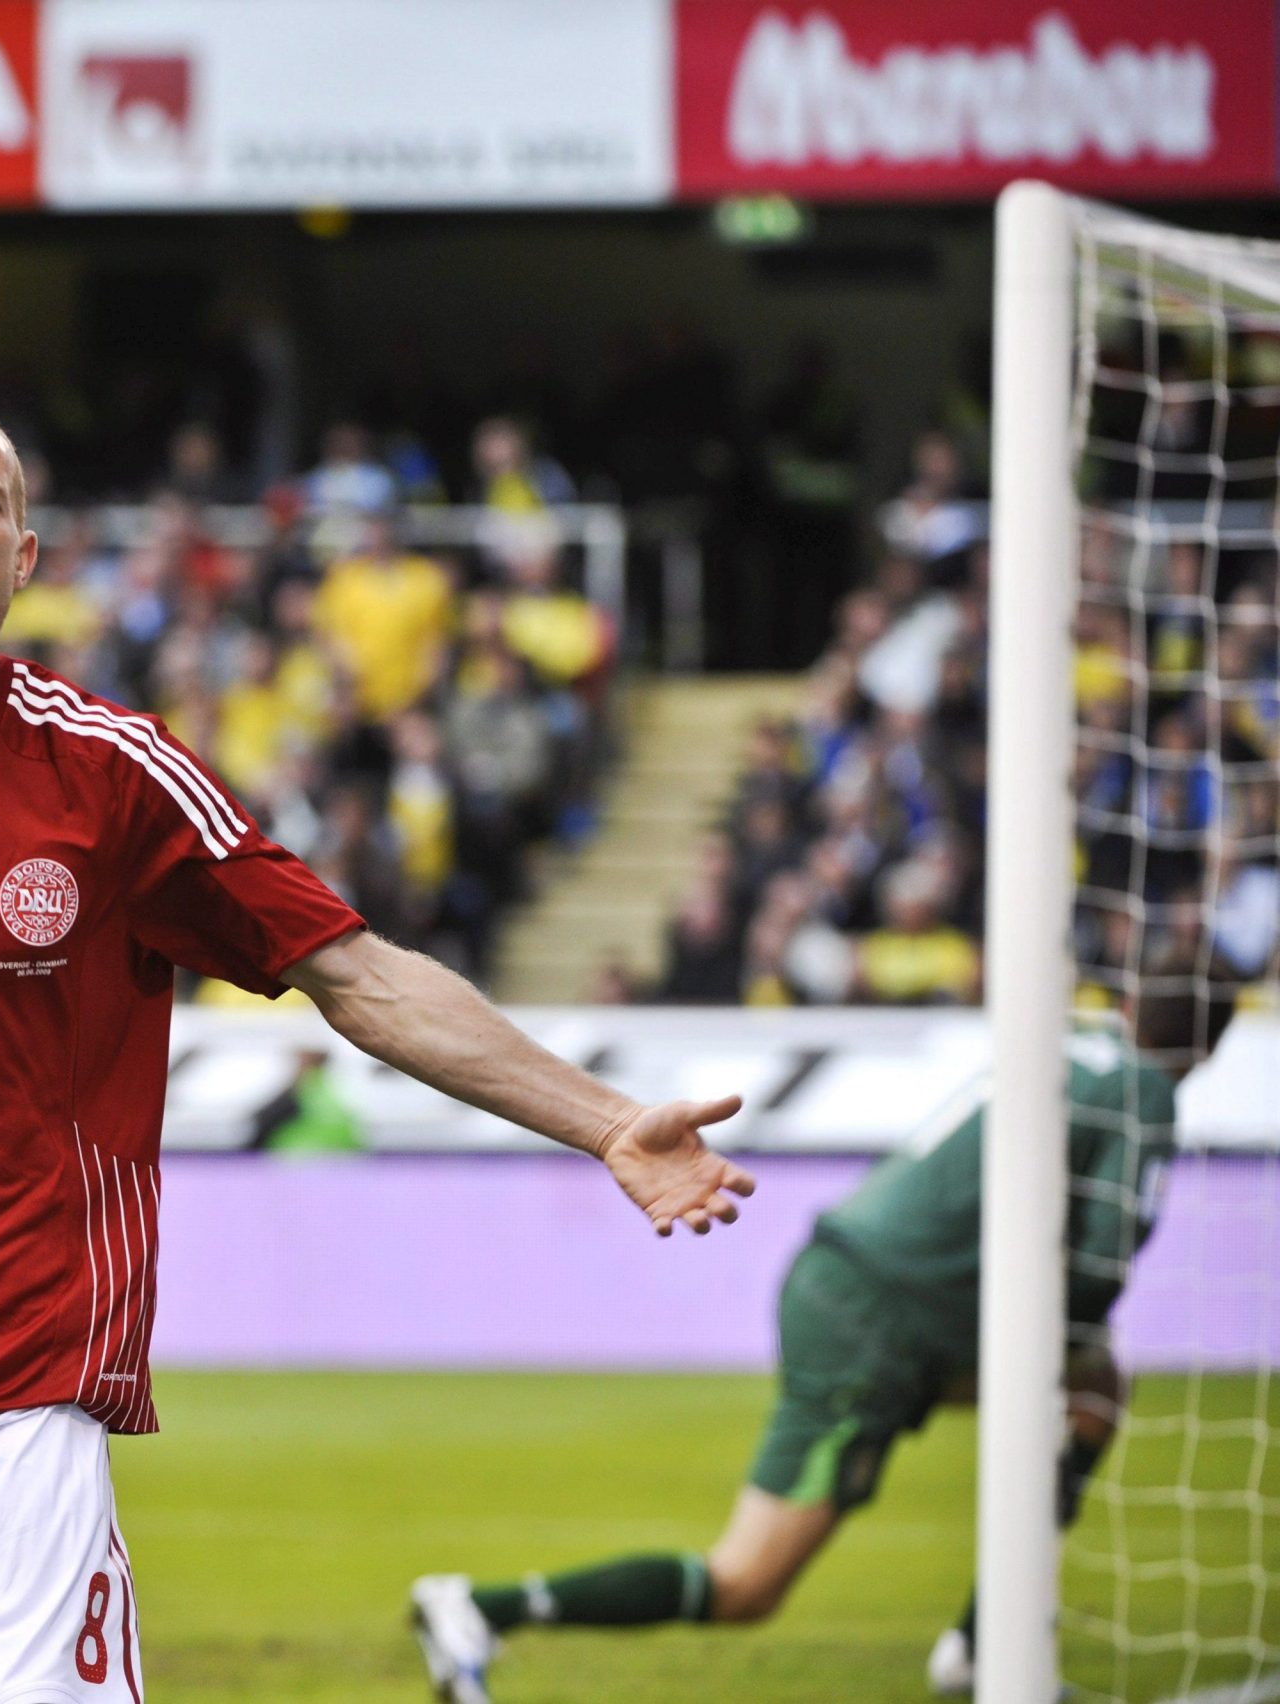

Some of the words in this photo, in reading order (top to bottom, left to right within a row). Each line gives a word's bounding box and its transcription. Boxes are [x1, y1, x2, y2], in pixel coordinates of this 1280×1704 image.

[1, 881, 24, 932] DANSK
[17, 888, 63, 914] DBU
[36, 958, 68, 968] DANMARK
[75, 1571, 110, 1684] 8
